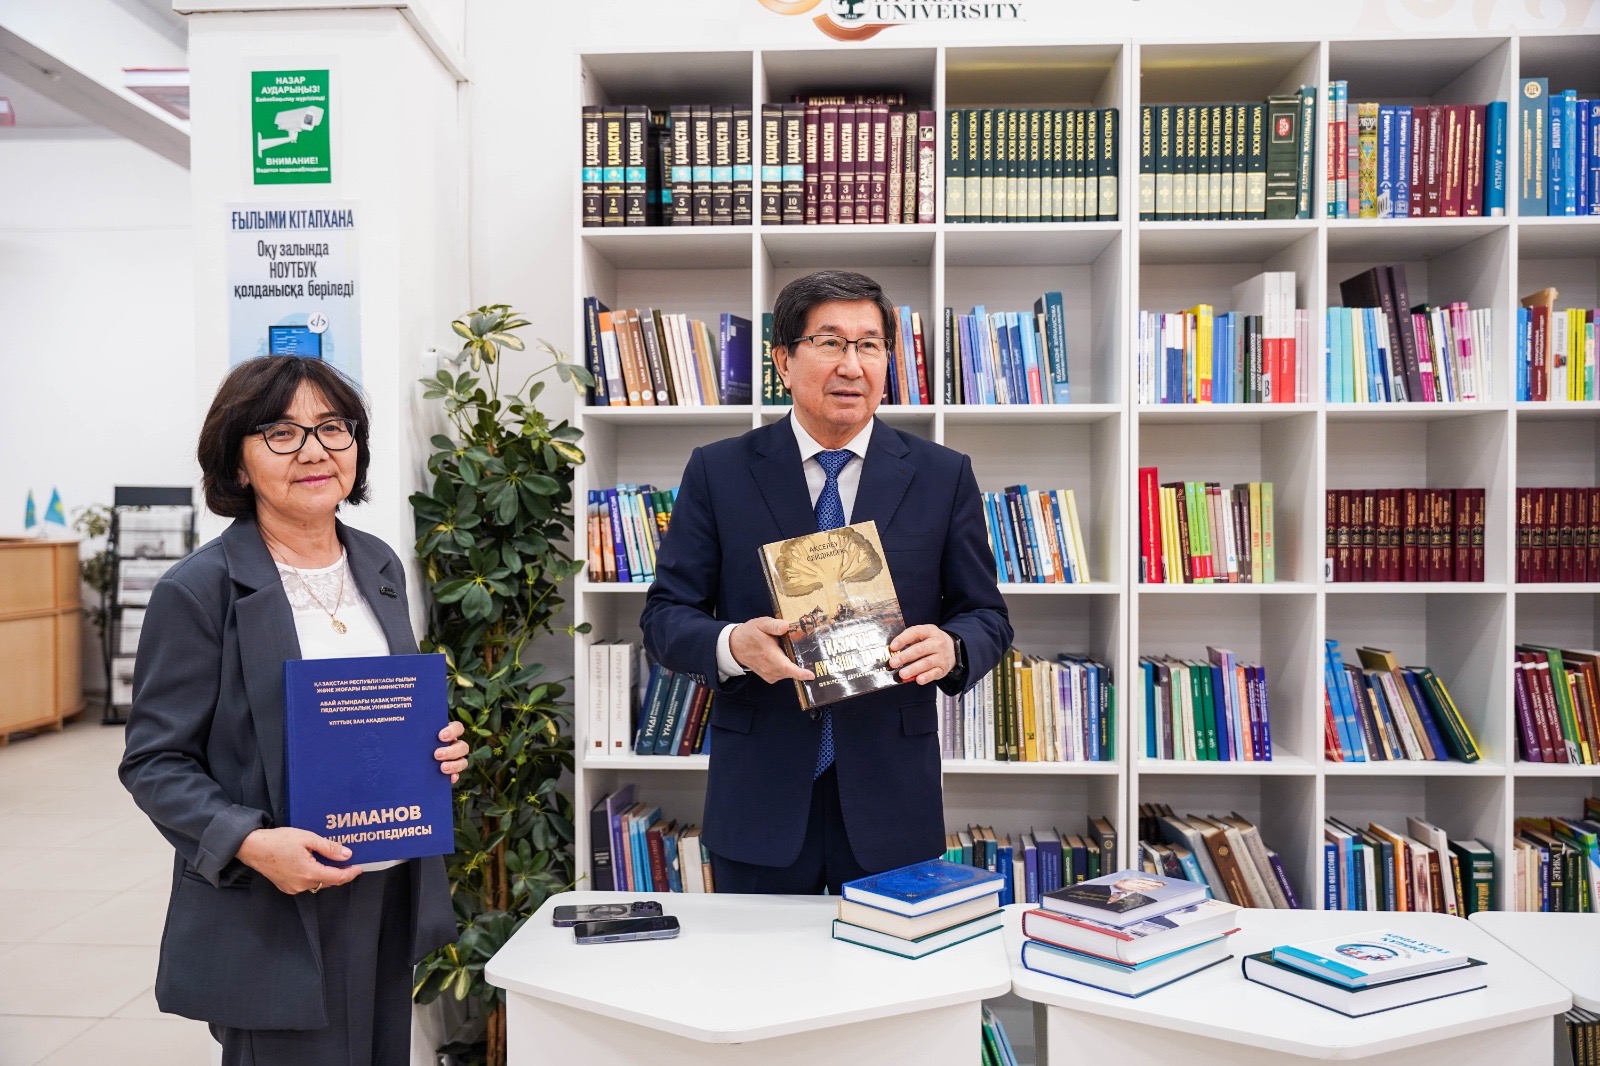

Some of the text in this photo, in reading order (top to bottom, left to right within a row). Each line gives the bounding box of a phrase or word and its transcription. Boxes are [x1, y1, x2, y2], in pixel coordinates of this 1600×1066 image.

[876, 4, 1022, 20] UNIVERSITY
[261, 85, 320, 95] АУДАРЫҢЫЗ!
[276, 76, 306, 84] НАЗАР
[951, 112, 959, 161] WORLD BOOK
[969, 112, 977, 161] WORLD BOOK
[1019, 112, 1027, 161] WORLD BOOK
[1054, 112, 1062, 161] WORLD BOOK
[1104, 112, 1112, 161] WORLD BOOK
[1143, 108, 1151, 157] WORLD BOOK
[1176, 108, 1184, 157] WORLD BOOK
[1188, 108, 1196, 157] WORLD BOOK
[1200, 108, 1208, 157] WORLD BOOK
[1212, 108, 1220, 157] WORLD BOOK
[1224, 107, 1233, 156] WORLD BOOK
[1237, 107, 1245, 156] WORLD BOOK
[1252, 107, 1261, 156] WORLD BOOK
[266, 156, 318, 166] ВНИМАНИЕ!
[232, 209, 354, 230] ҒЫЛЫМИ КІТАПХАНА
[257, 240, 330, 260] Оқу залында
[269, 262, 317, 278] НОУТБУК
[234, 280, 354, 299] қолданысқа беріледі
[1391, 333, 1401, 372] ДАРАБОЗ
[1406, 332, 1416, 372] ДАРАБОЗ
[320, 702, 412, 713] ПЕДАГОГИКАЛЫҚ УНИВЕРСИТЕТІ
[324, 824, 432, 846] НЦИКЛОПЕДИЯСЫ
[326, 805, 422, 829] ЗИМАНОВ
[1553, 853, 1561, 880] ЭТИКА
